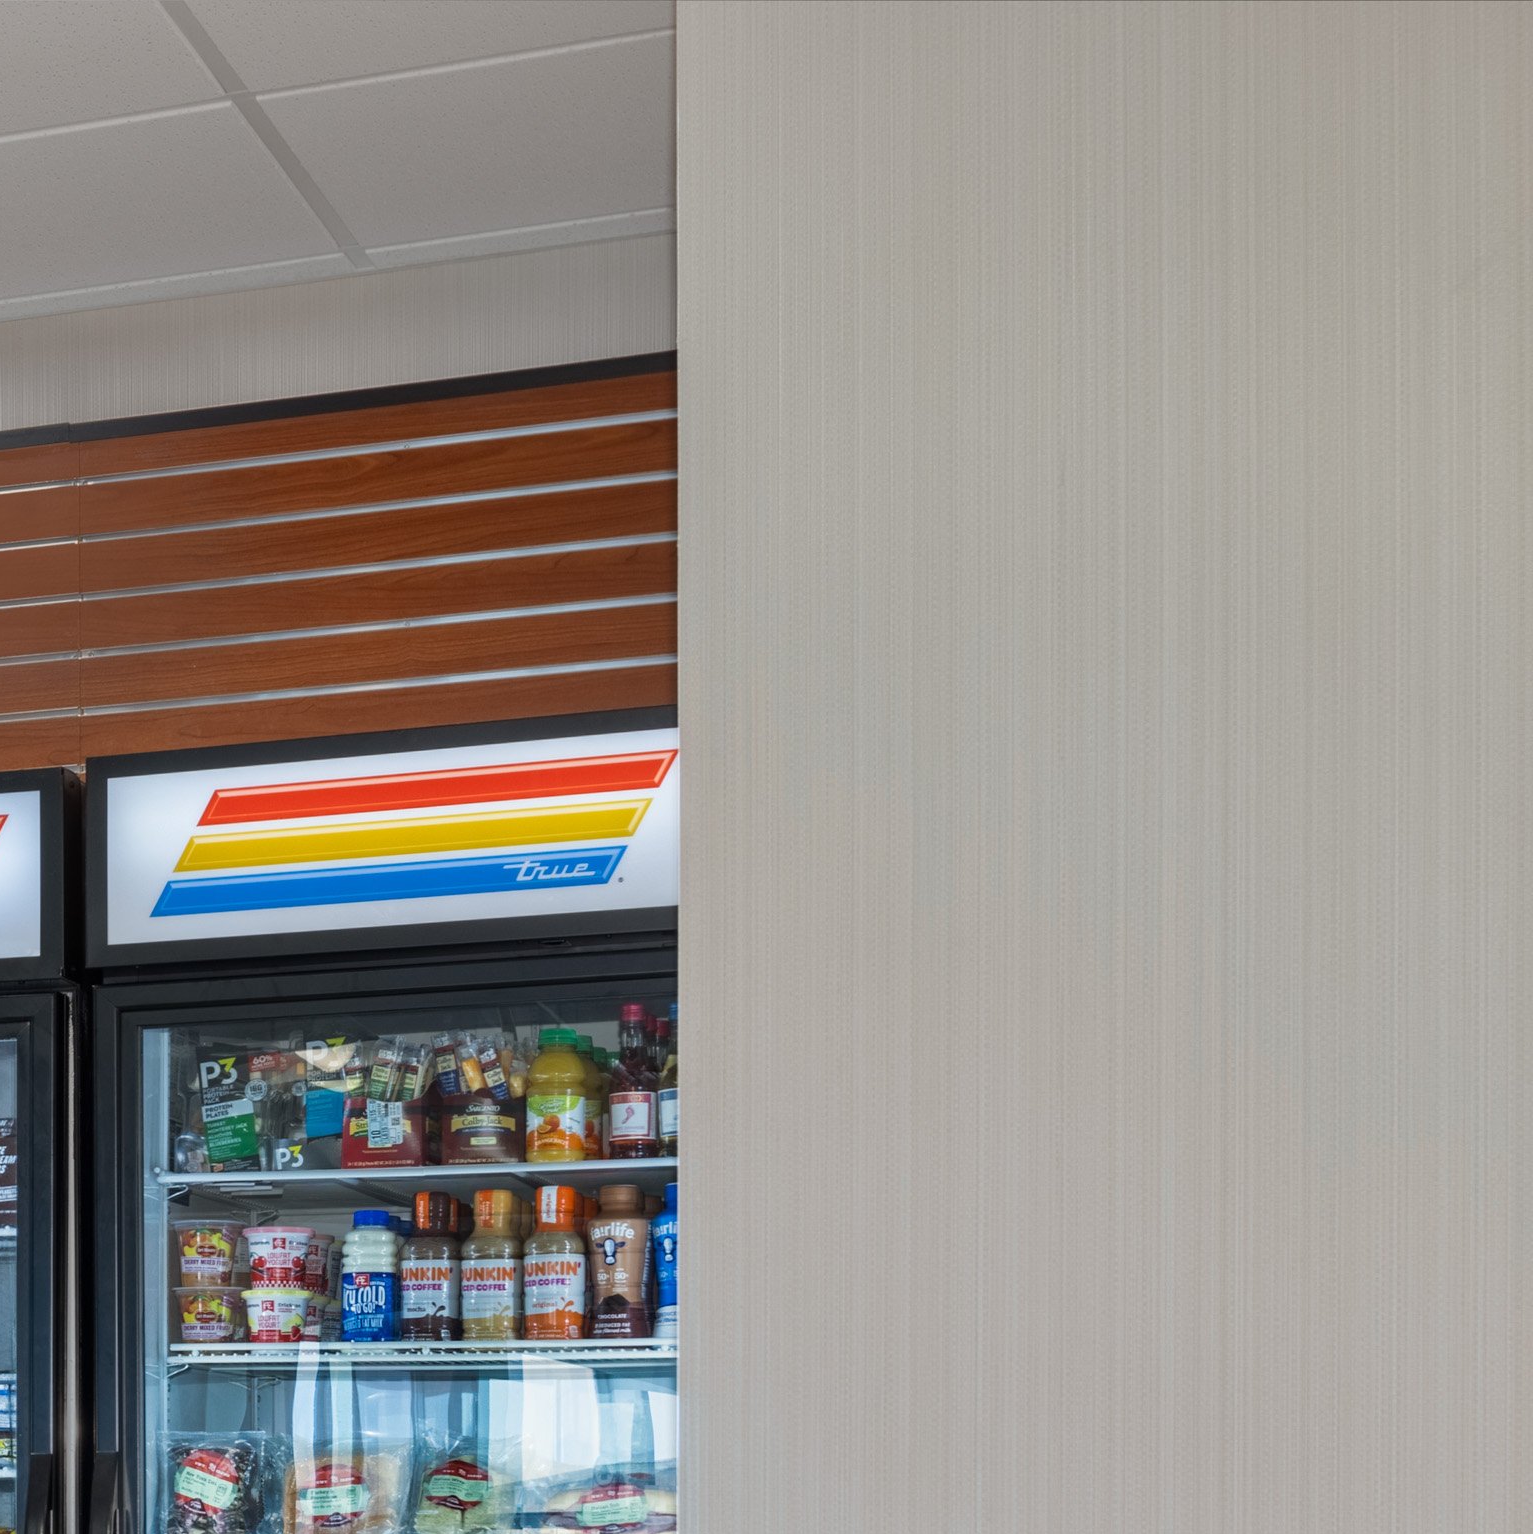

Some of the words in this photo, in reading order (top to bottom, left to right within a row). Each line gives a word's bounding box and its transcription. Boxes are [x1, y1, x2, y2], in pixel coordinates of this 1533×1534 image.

[503, 860, 595, 882] true
[200, 1056, 238, 1088] P3
[205, 1104, 233, 1113] PROTEIN
[206, 1109, 229, 1117] PLATES
[276, 1145, 304, 1168] P3
[590, 1222, 635, 1240] fairlife
[412, 1283, 442, 1291] COFFEE
